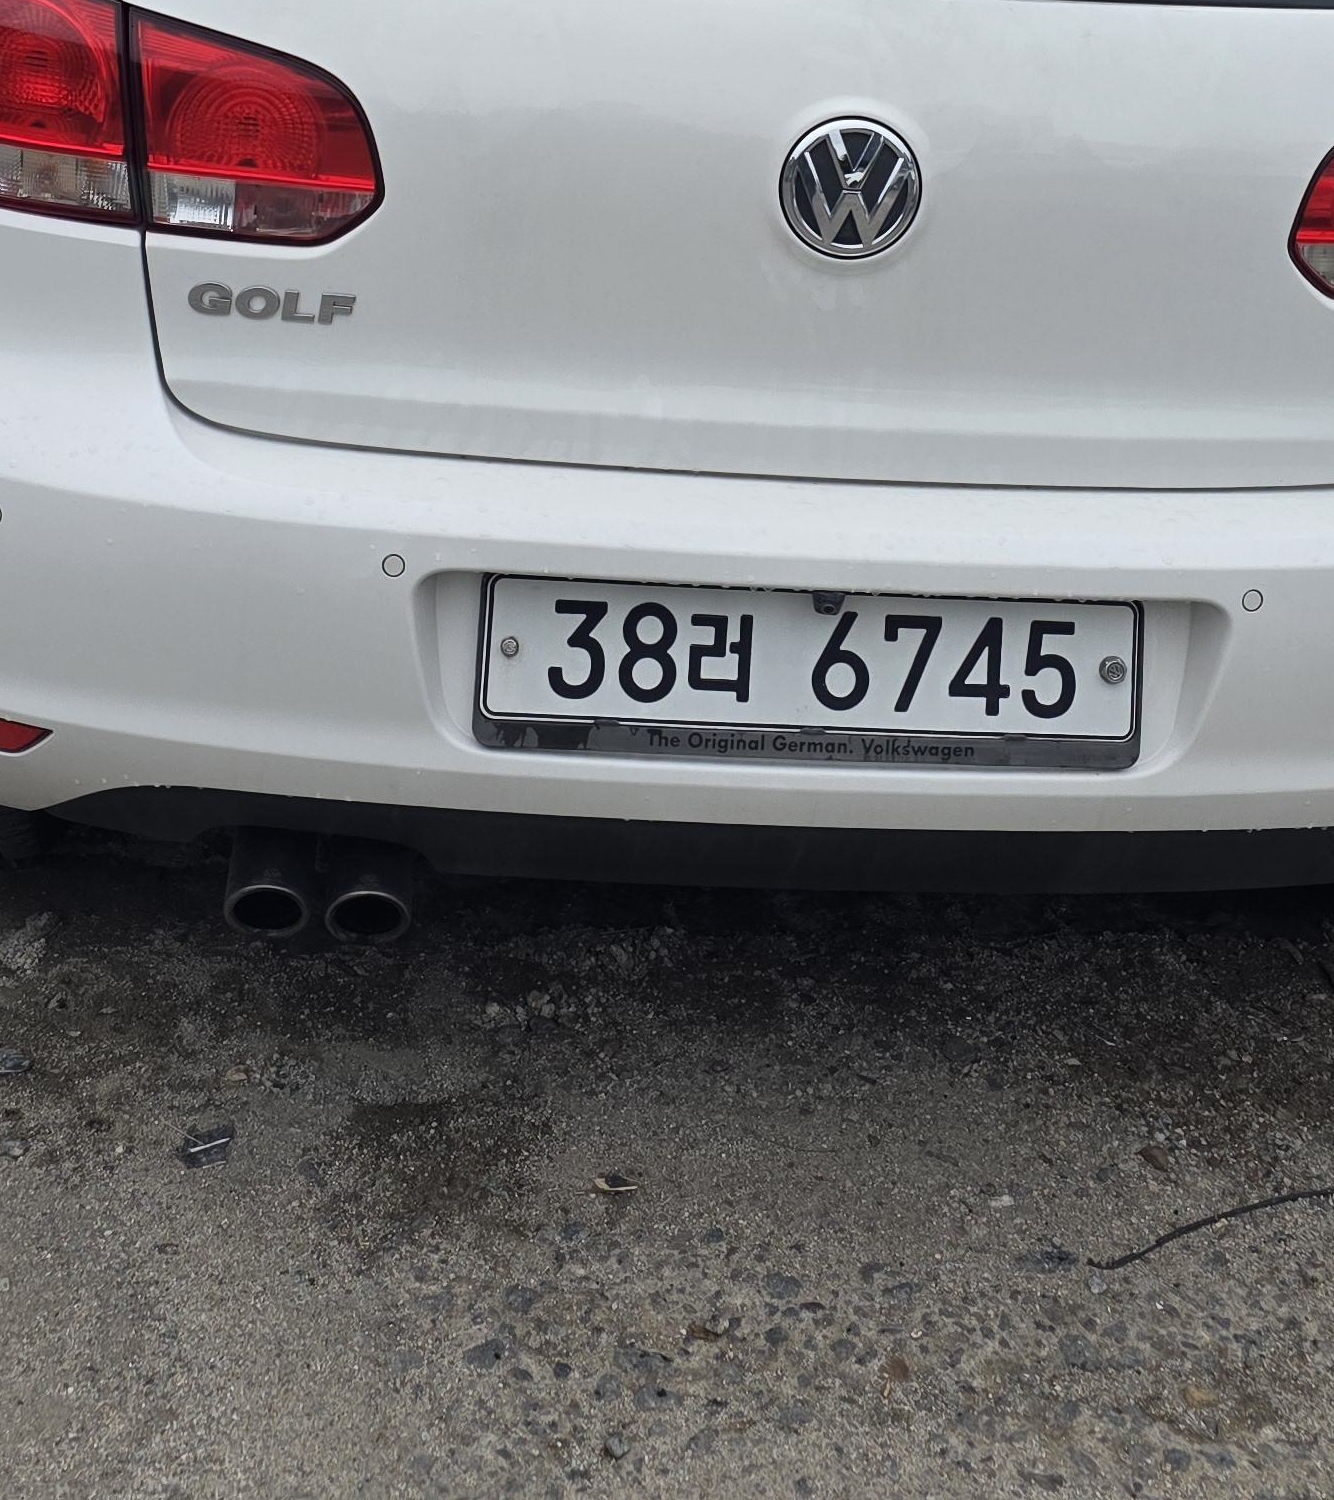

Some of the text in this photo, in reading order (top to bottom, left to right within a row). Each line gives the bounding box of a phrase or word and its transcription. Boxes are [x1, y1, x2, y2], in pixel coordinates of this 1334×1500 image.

[187, 280, 357, 325] GOLF
[547, 598, 1077, 719] 38러 6745
[646, 729, 681, 748] The
[687, 731, 766, 752] Original
[860, 737, 975, 762] Volkswagen
